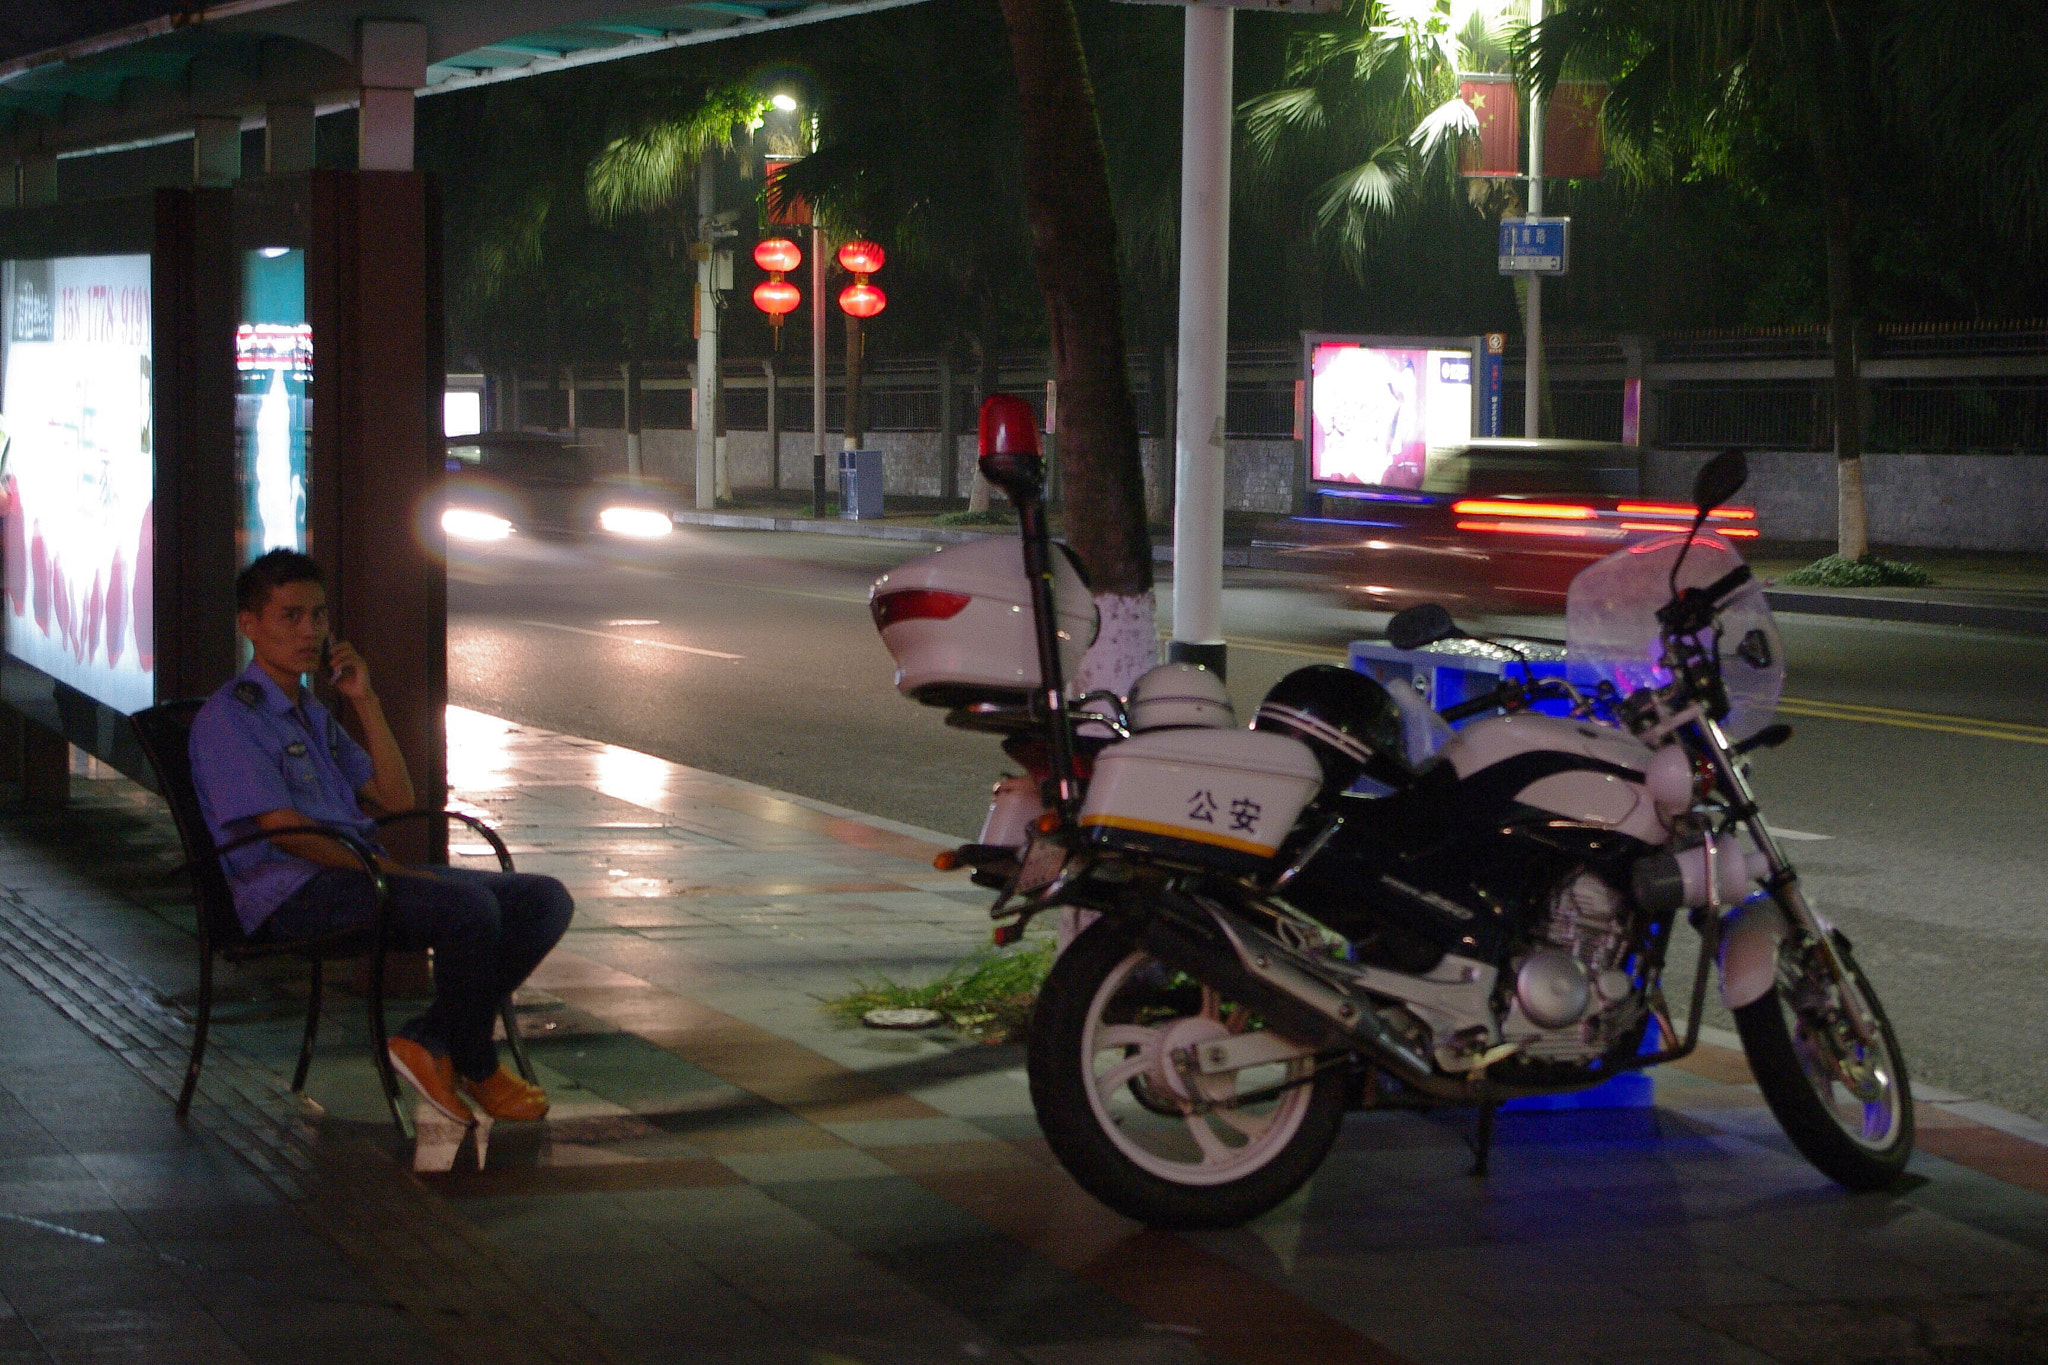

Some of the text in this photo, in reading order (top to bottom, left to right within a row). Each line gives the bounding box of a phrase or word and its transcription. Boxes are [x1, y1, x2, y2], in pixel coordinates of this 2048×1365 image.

[62, 285, 81, 341] 158
[87, 285, 114, 343] 1778
[1188, 789, 1261, 834] 公安
